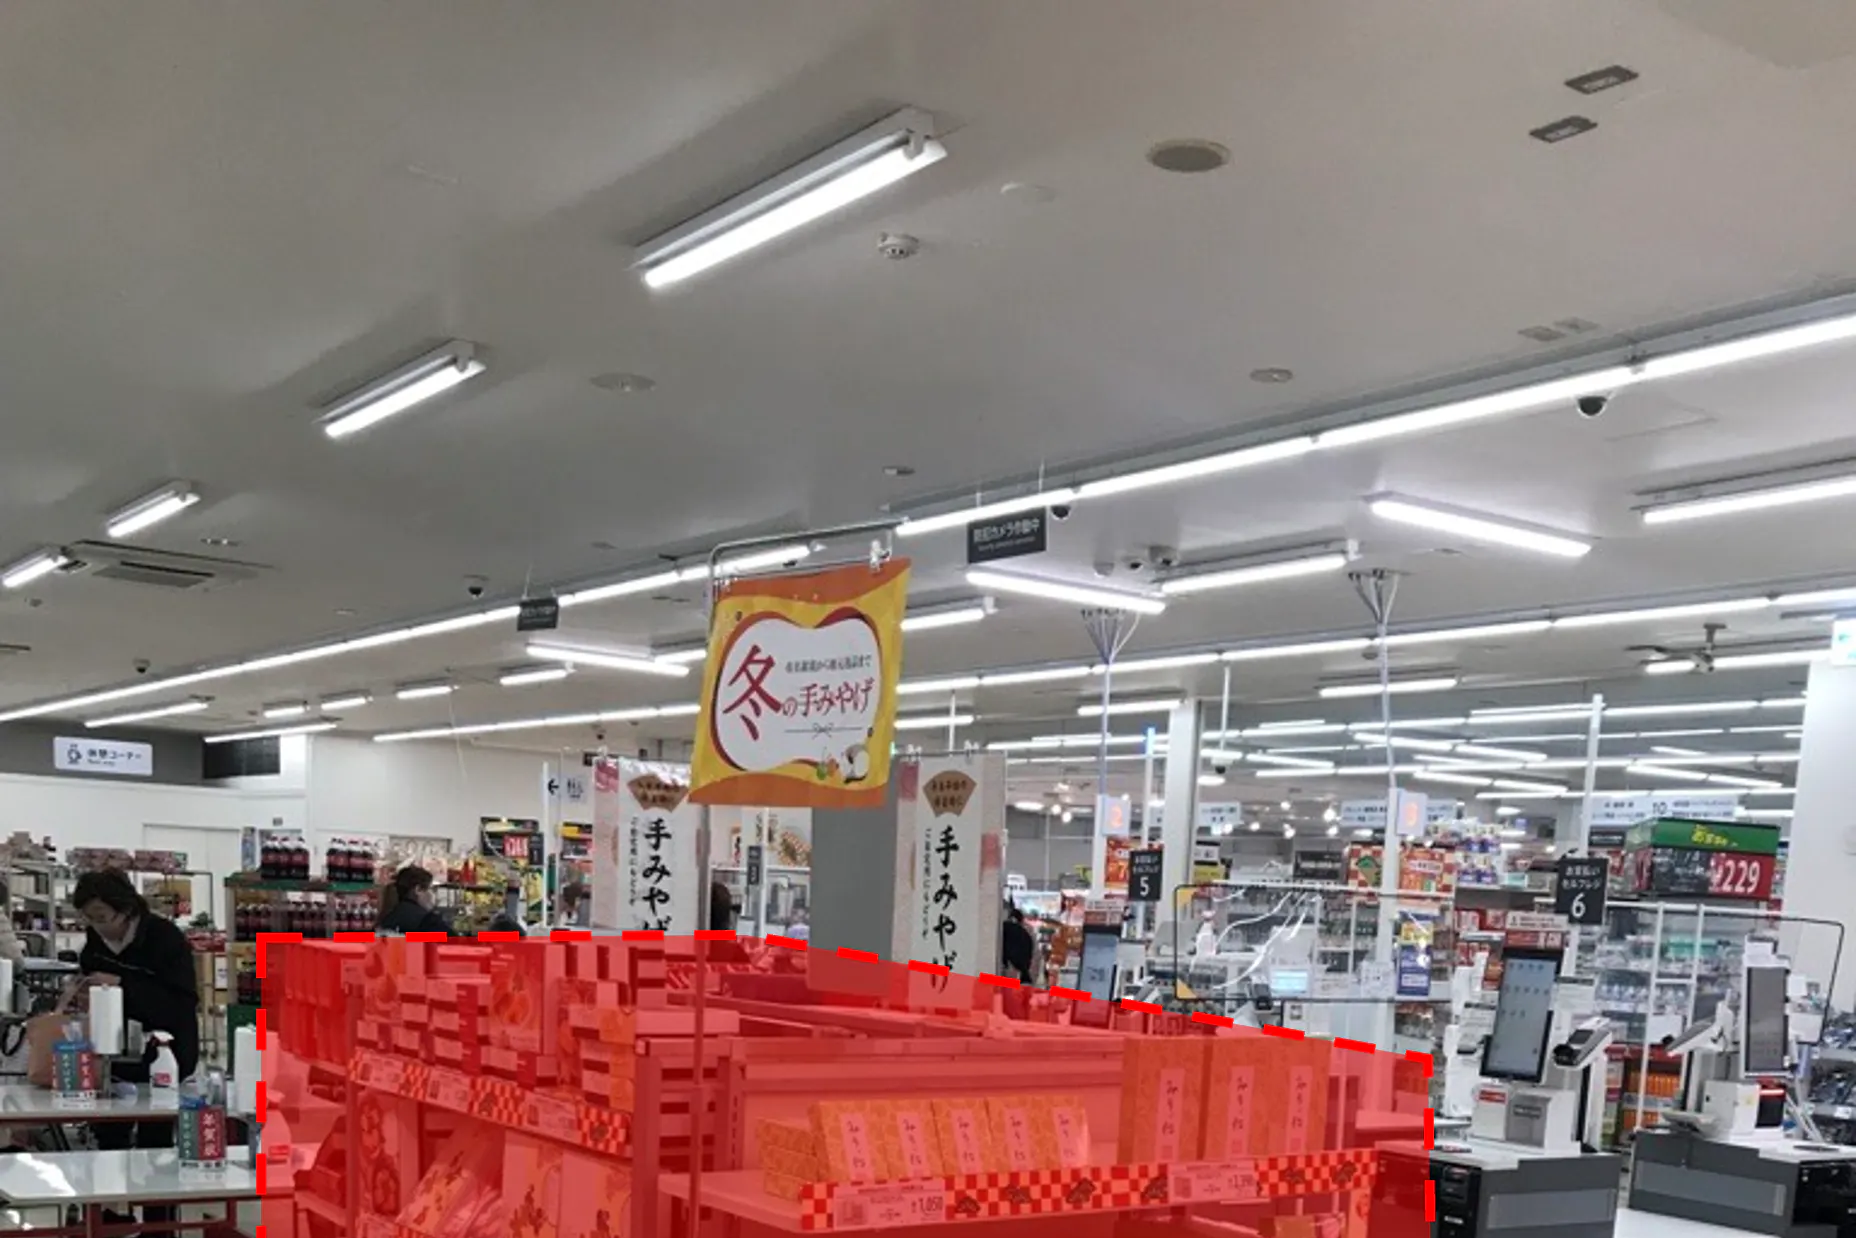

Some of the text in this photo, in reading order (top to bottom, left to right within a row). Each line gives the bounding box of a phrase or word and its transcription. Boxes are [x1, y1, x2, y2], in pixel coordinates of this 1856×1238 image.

[722, 644, 875, 741] 冬の手みやげ
[1140, 876, 1149, 897] 5
[1571, 892, 1586, 919] 6
